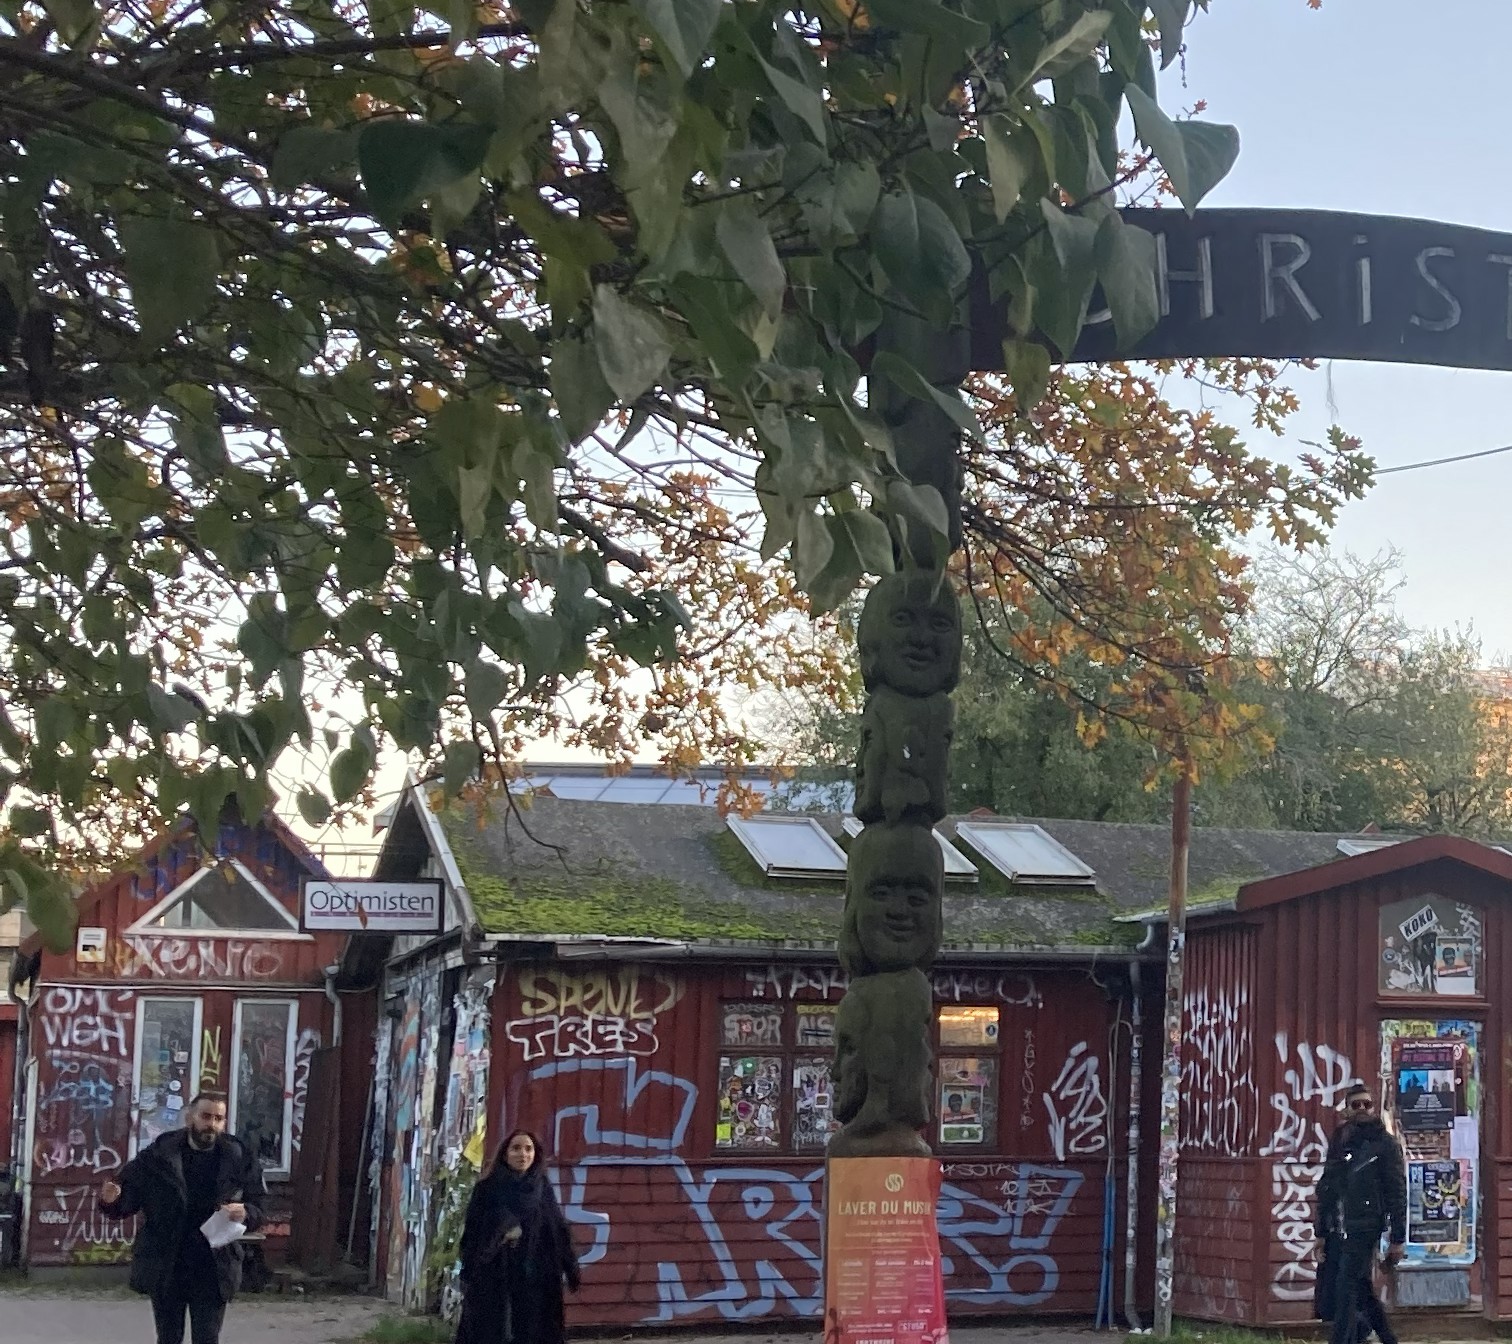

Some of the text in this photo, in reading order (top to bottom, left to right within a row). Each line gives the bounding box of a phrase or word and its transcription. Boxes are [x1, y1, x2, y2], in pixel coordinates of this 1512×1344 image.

[310, 889, 434, 912] Optimisten
[1403, 908, 1434, 938] KOKO
[838, 1200, 877, 1216] LAVER
[881, 1199, 899, 1215] DU
